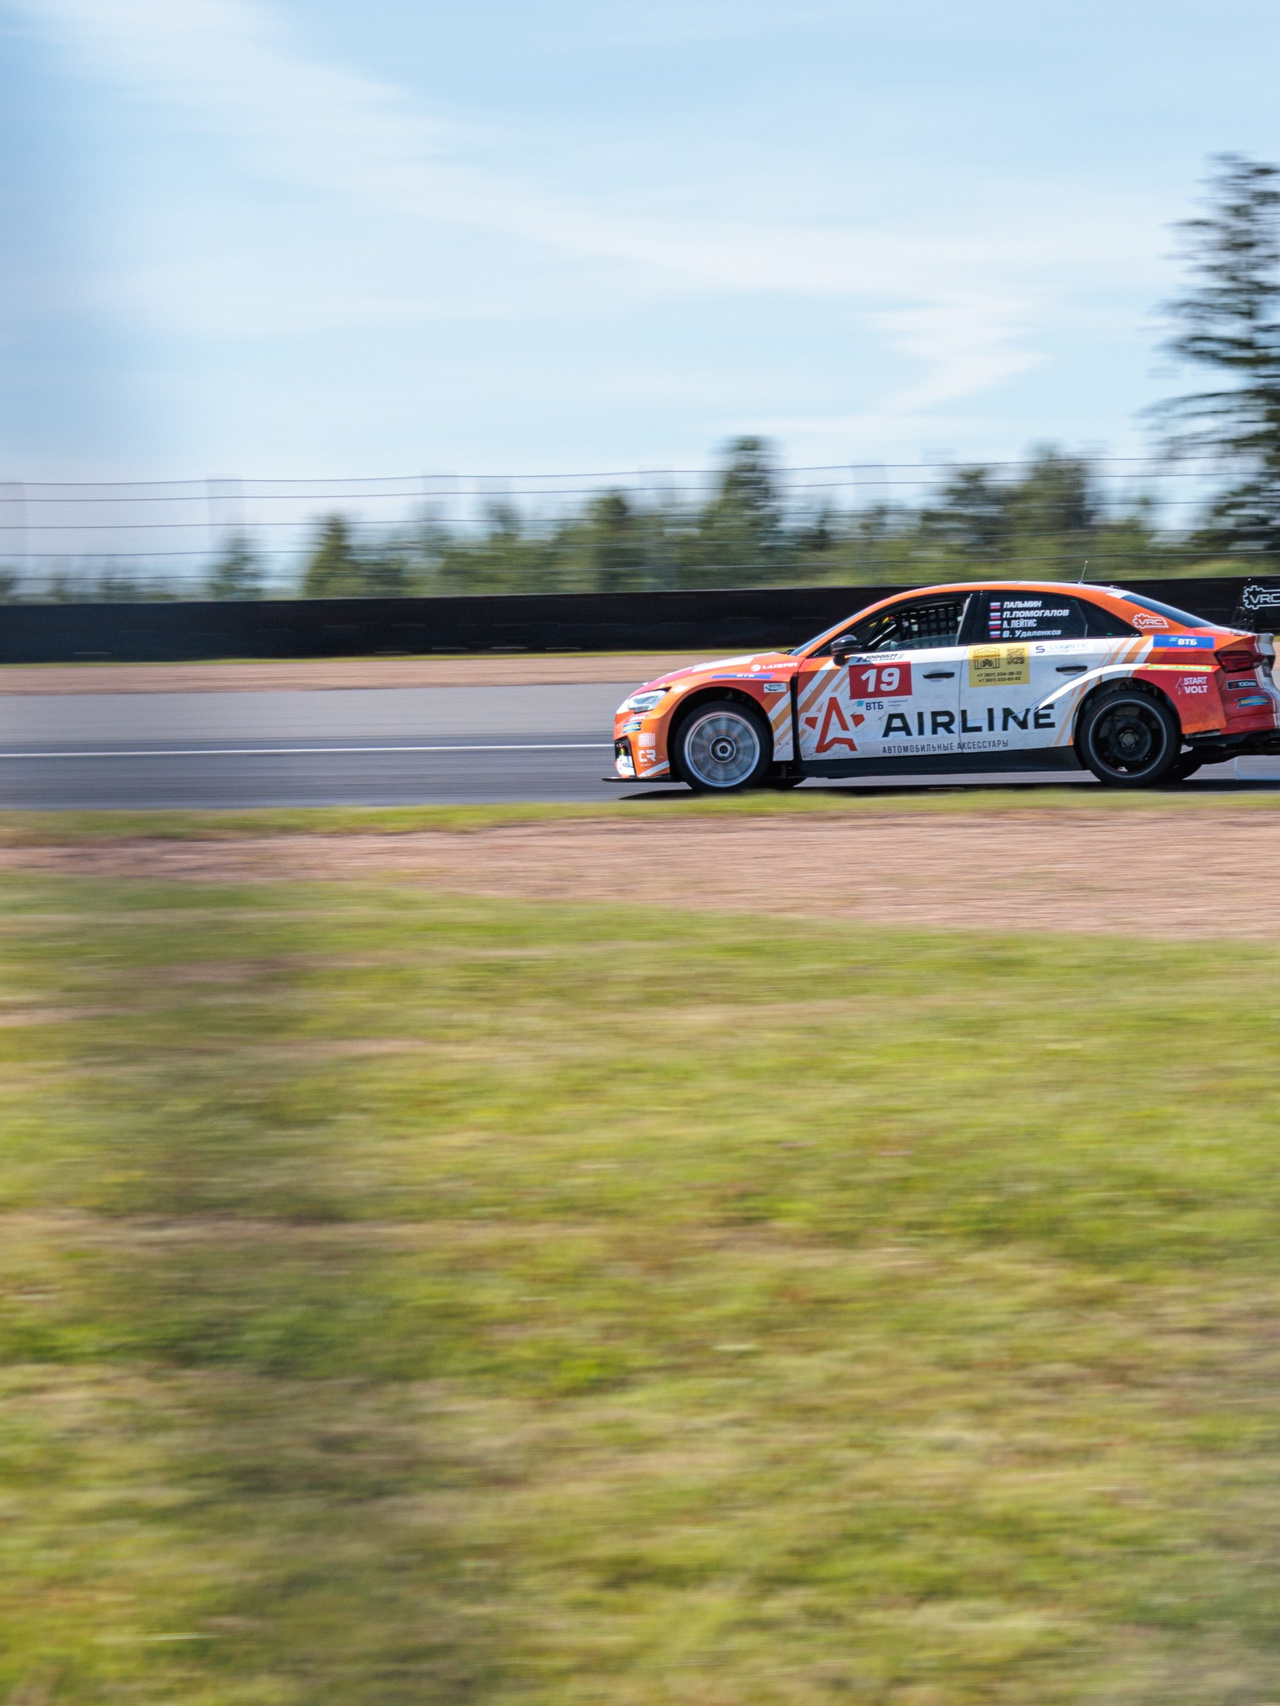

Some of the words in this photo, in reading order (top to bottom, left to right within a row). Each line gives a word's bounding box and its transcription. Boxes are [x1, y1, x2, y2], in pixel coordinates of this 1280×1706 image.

[1249, 593, 1280, 604] VRC
[1003, 600, 1042, 609] ПАЛЬМИН
[1177, 638, 1197, 646] ВТБ
[860, 667, 901, 693] 19
[1183, 676, 1208, 685] START
[1184, 685, 1208, 694] VOLT
[865, 701, 884, 711] ВТБ
[881, 703, 1056, 738] AIRLINE
[882, 742, 954, 754] АВТОМОБИЛЬНЫЕ
[957, 739, 1009, 751] АКСЕССУАРЫ
